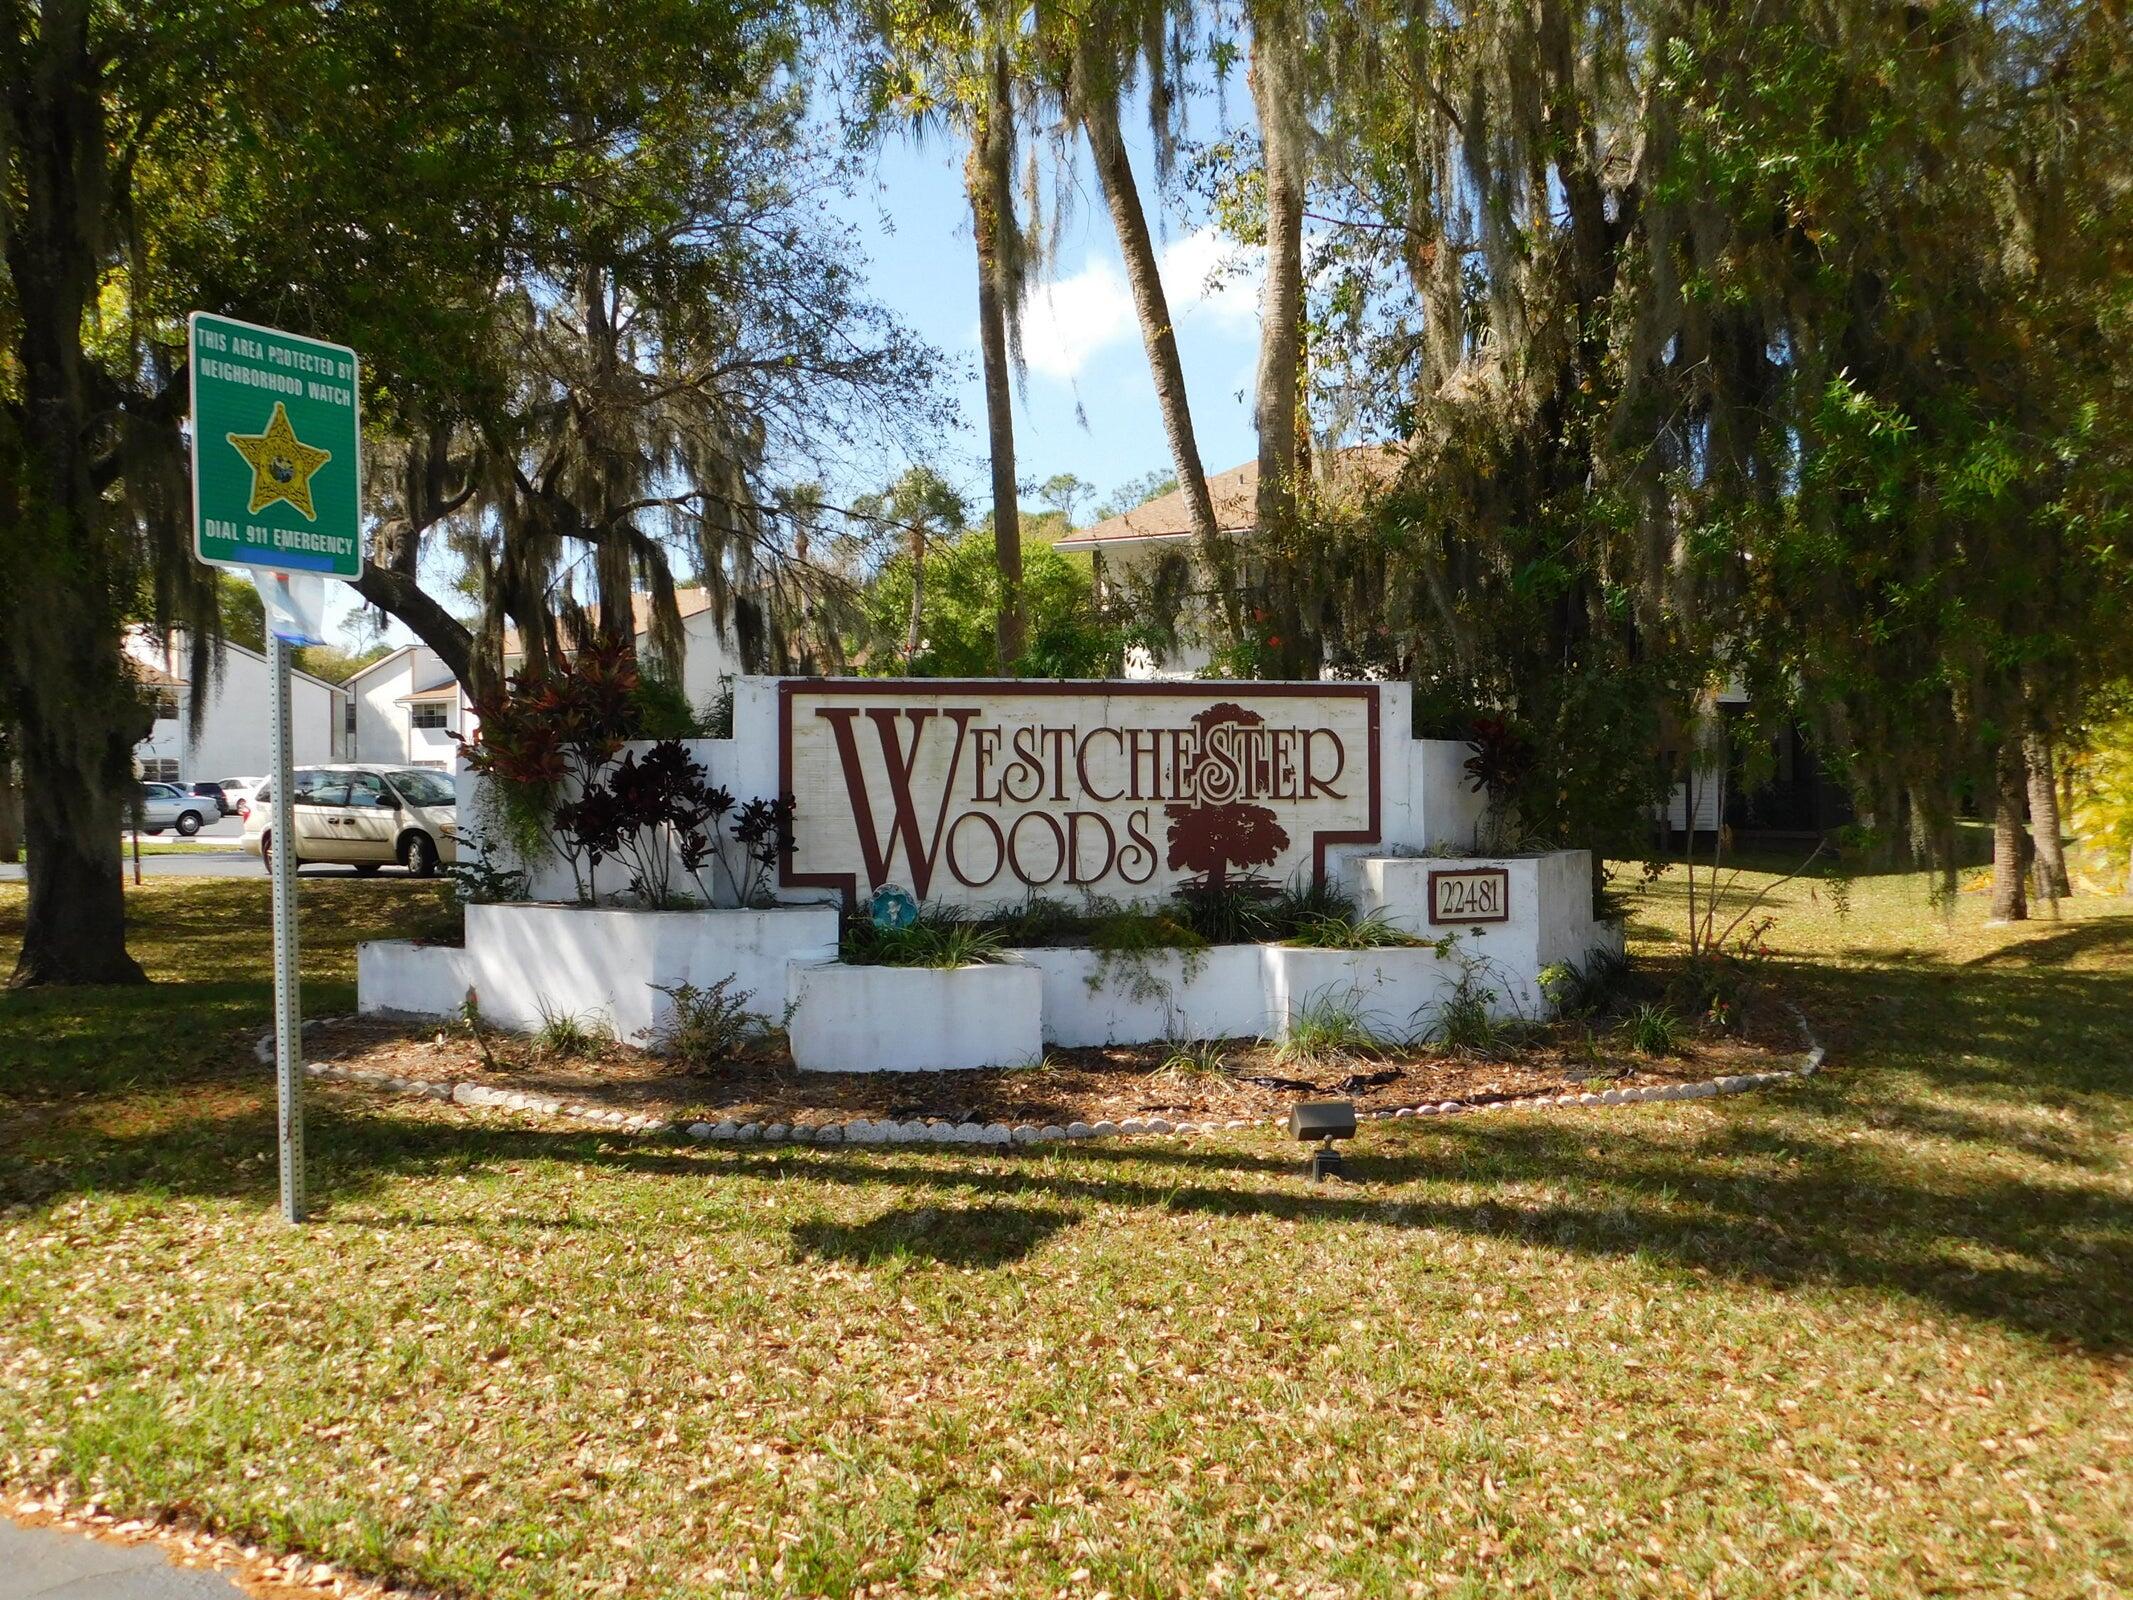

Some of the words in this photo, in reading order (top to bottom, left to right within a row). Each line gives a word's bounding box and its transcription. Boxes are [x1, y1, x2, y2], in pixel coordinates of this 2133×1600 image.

[197, 327, 227, 352] THIS
[232, 336, 264, 360] AREA
[268, 344, 334, 376] PROTECTED
[338, 362, 352, 380] BY
[200, 357, 303, 396] NEIGHBORHOOD
[308, 381, 350, 407] WATCH
[205, 518, 239, 541] DIAL
[246, 525, 268, 544] 911
[273, 528, 353, 556] EMERGENCY
[815, 707, 1347, 901] WESTCHESTER
[1440, 879, 1500, 914] 22481
